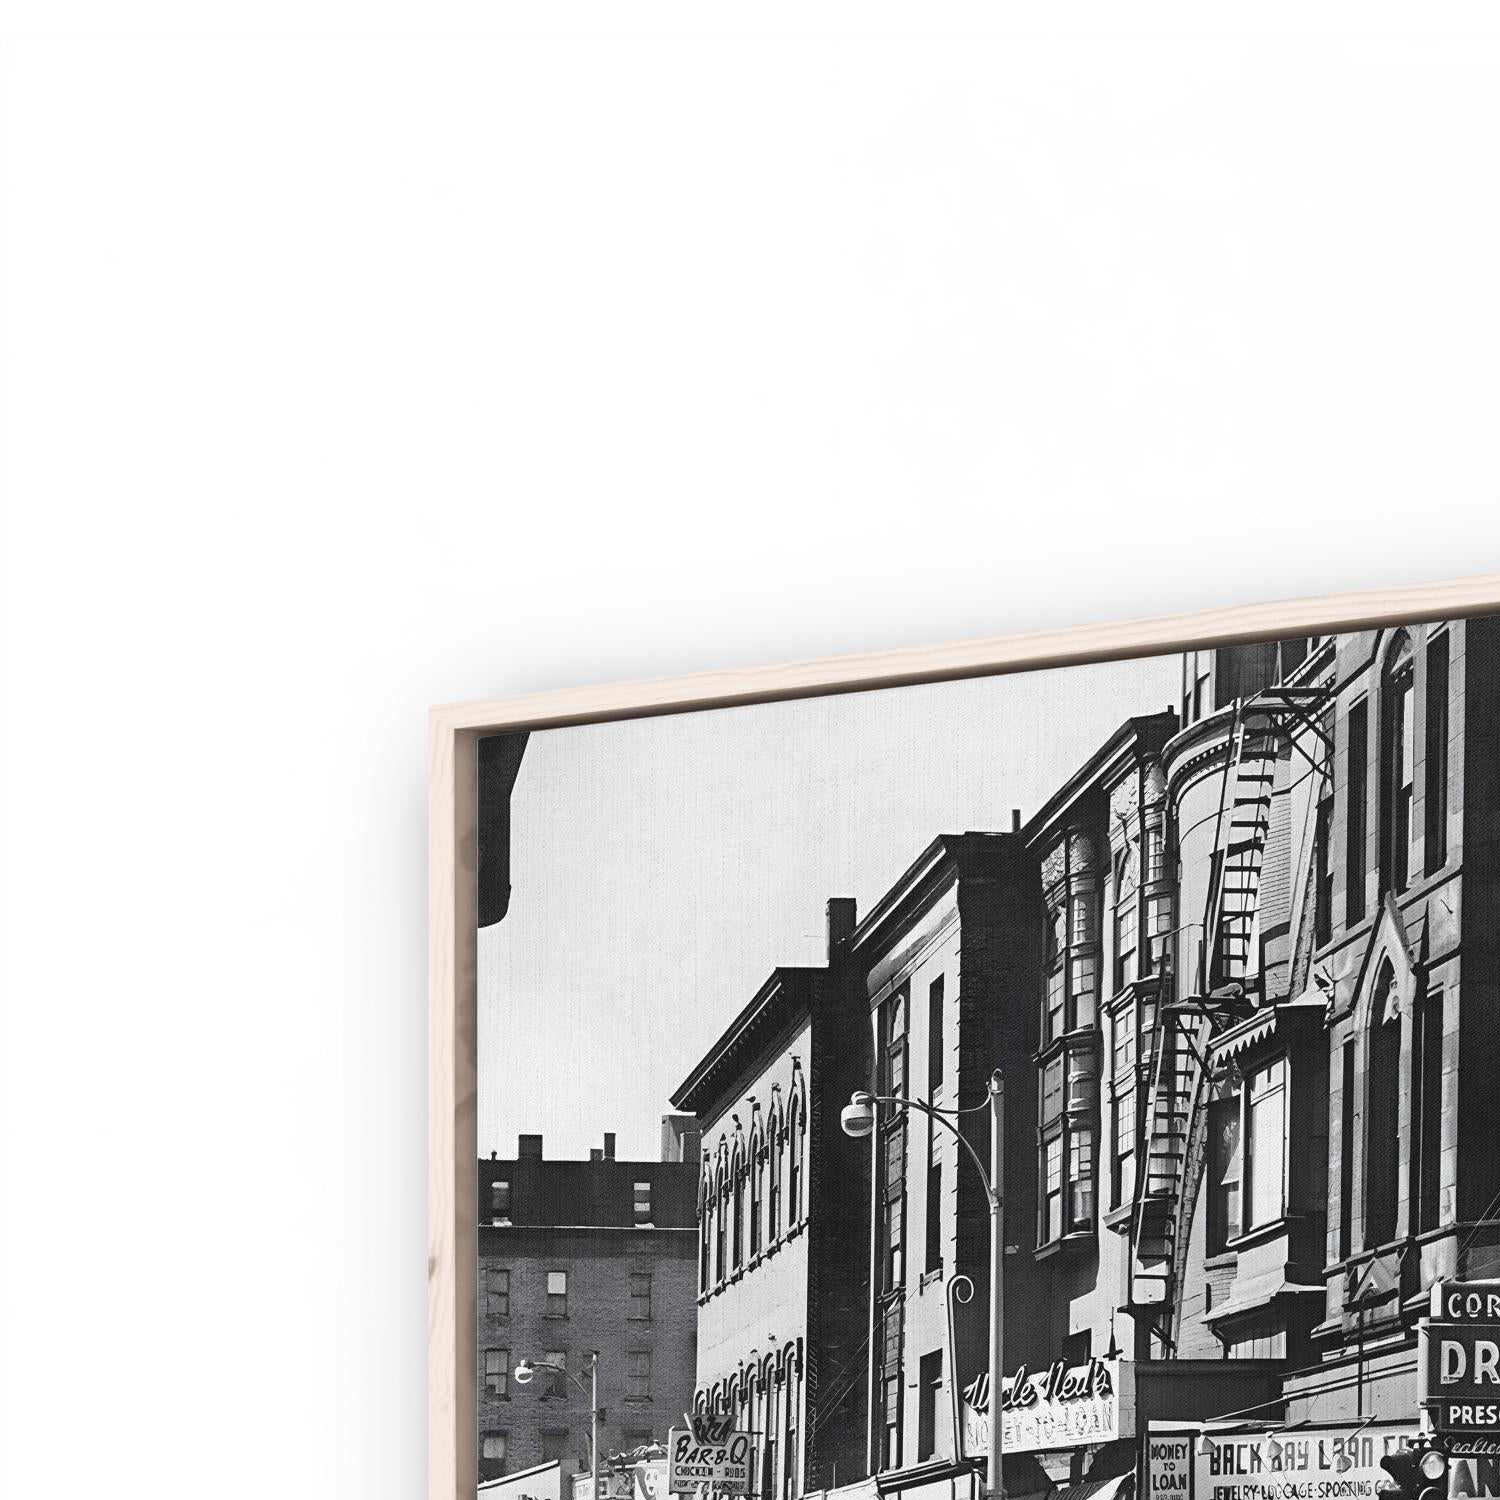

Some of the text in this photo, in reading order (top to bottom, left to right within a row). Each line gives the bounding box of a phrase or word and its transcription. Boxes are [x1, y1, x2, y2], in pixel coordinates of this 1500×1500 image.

[962, 1363, 1037, 1411] Ucle
[674, 1434, 749, 1466] BAR-B-Q
[1150, 1443, 1188, 1460] MONEY
[1209, 1442, 1262, 1476] BACK
[1163, 1461, 1176, 1472] TO
[1152, 1473, 1188, 1491] LOAN
